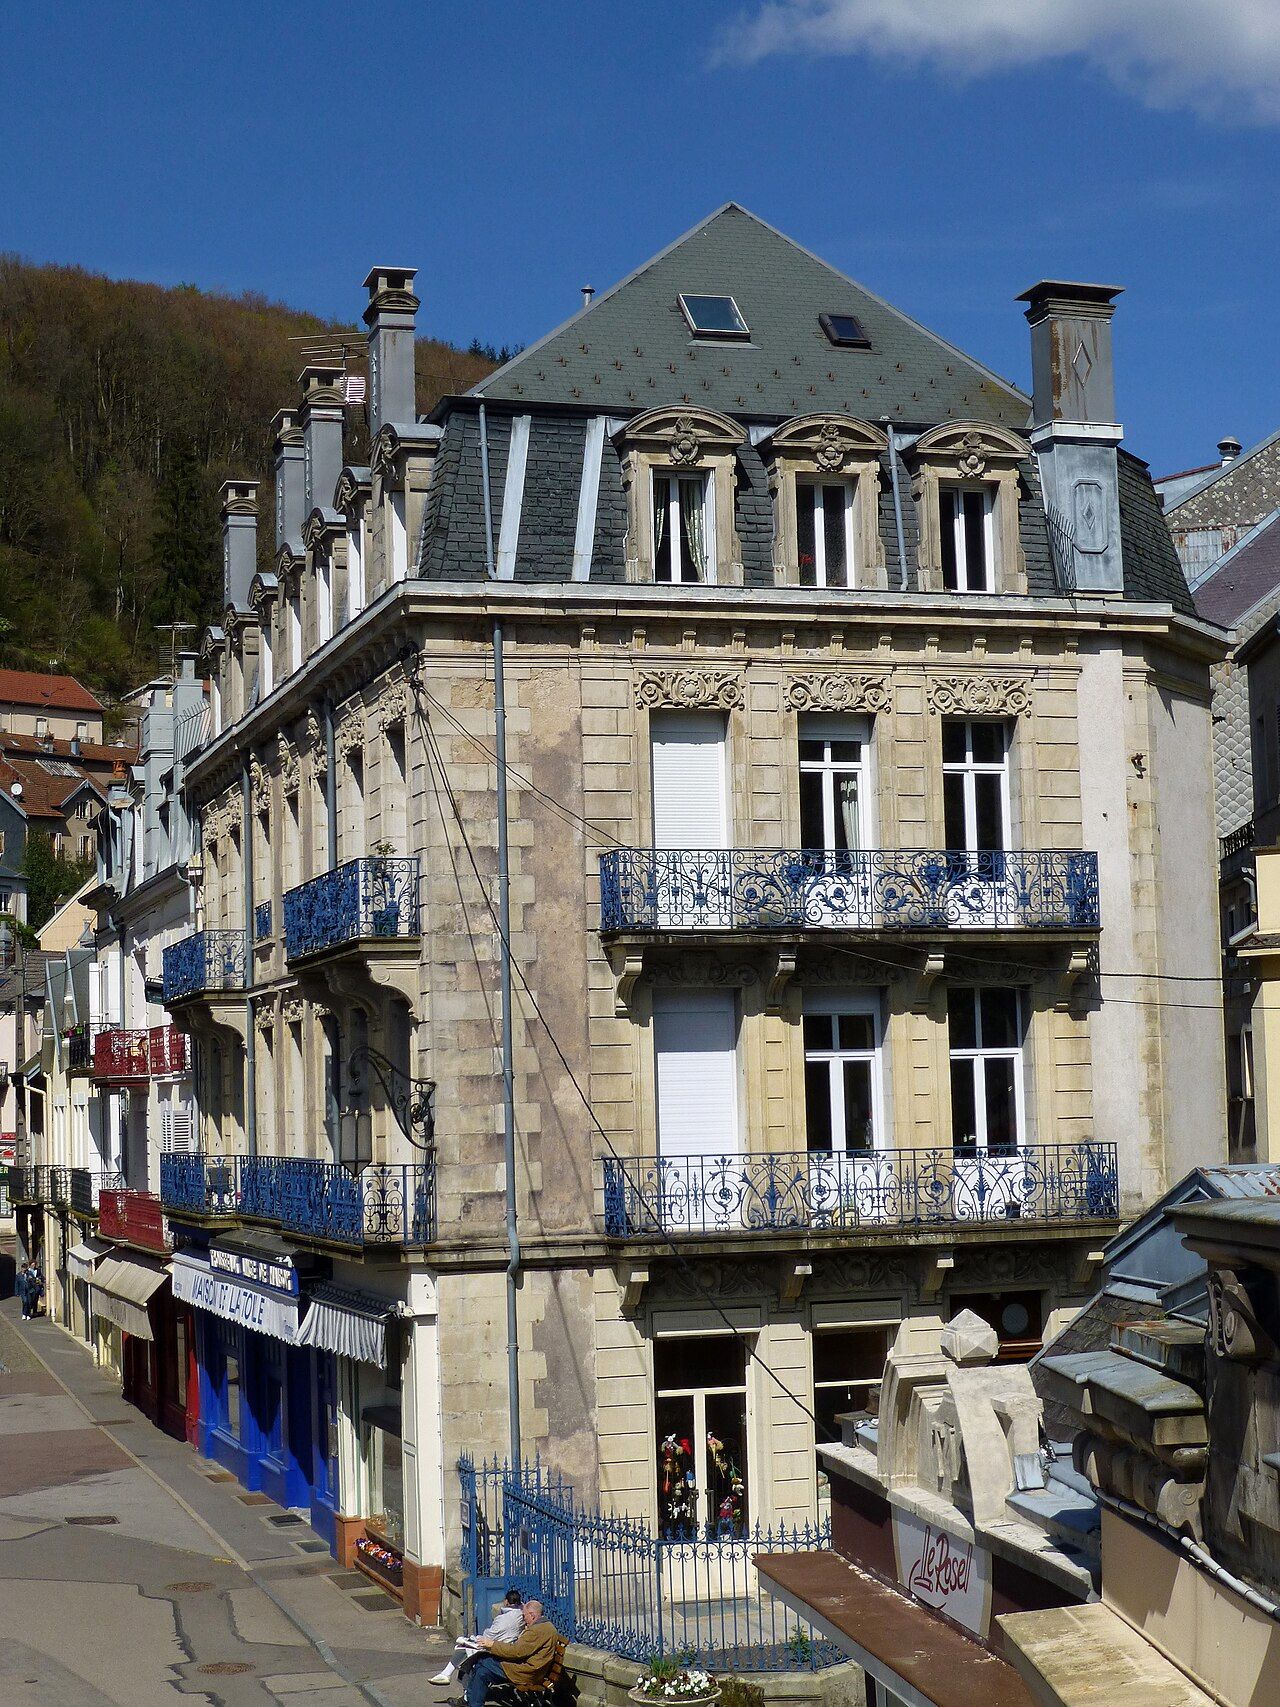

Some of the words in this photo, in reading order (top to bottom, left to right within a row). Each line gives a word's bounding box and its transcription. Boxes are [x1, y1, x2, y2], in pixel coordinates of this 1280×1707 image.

[191, 1274, 217, 1308] MAISON
[229, 1286, 241, 1315] LA
[912, 1525, 935, 1593] Le
